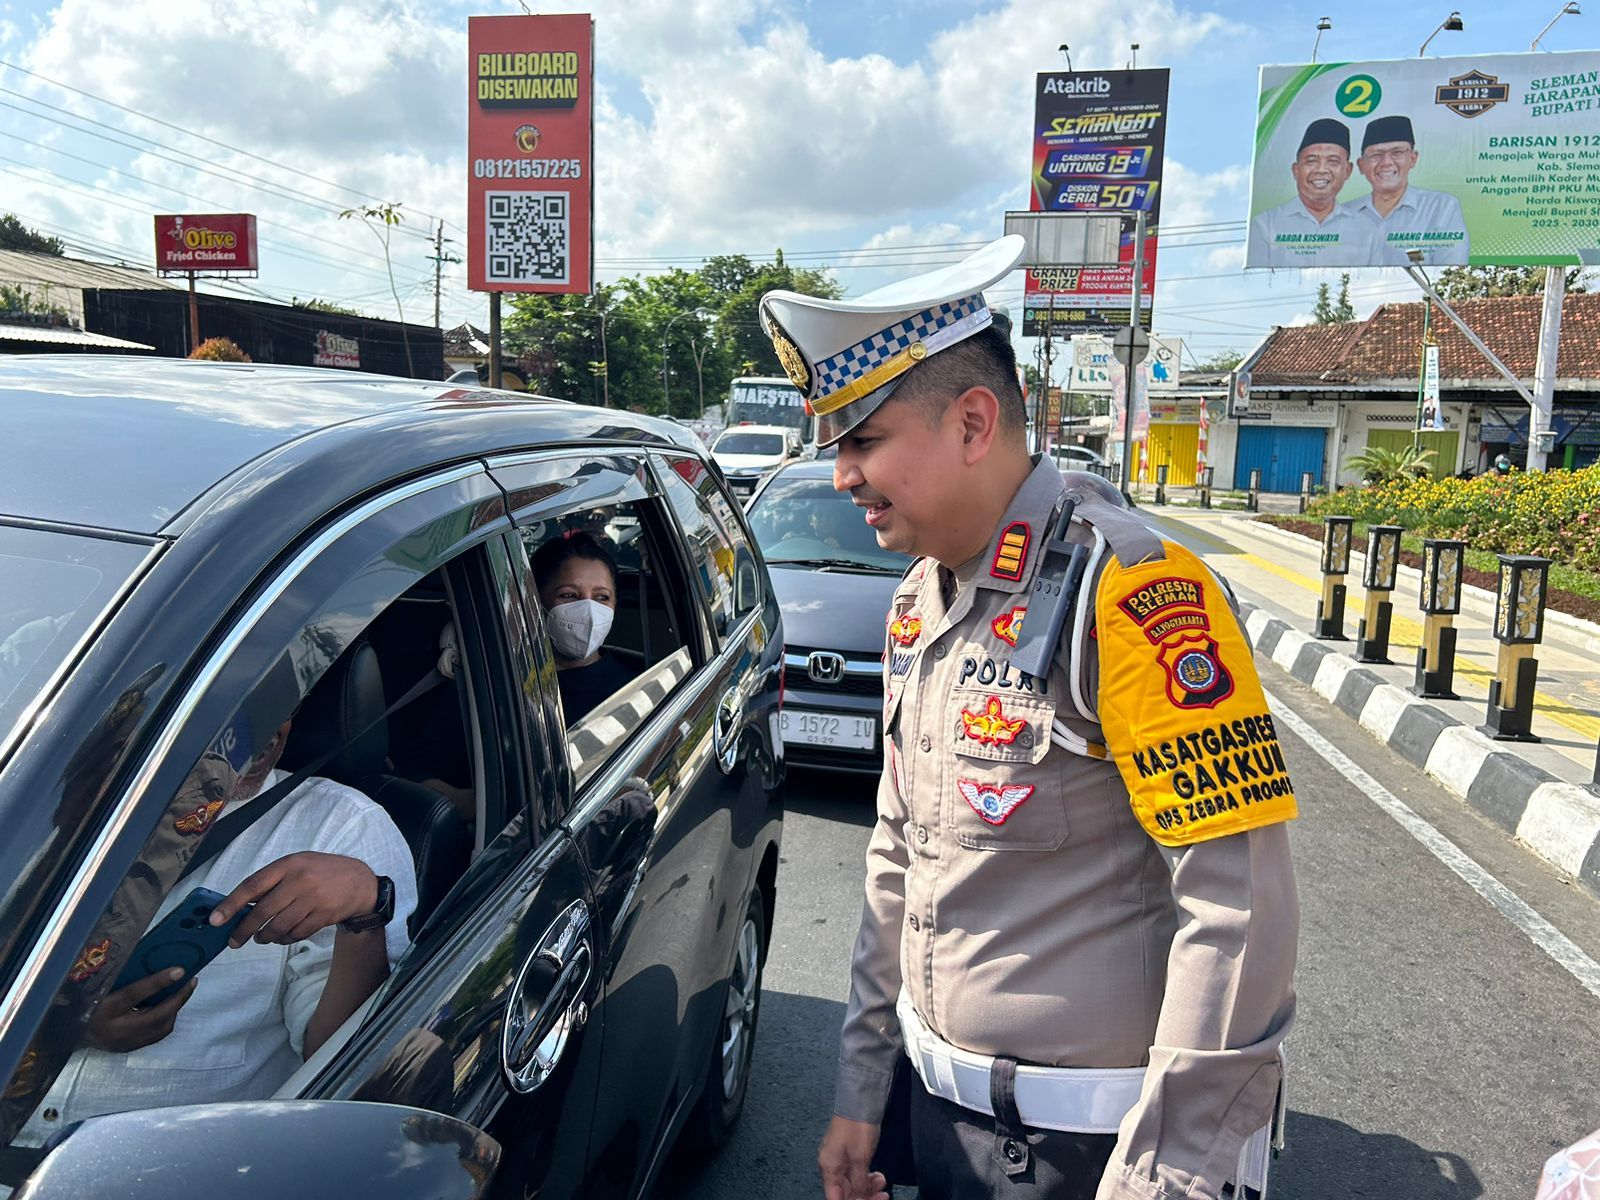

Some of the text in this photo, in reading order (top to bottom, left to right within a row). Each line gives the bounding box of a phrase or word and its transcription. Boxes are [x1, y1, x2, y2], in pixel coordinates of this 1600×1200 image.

[478, 52, 578, 76] BILLBOARD
[478, 78, 578, 100] DISEWAKAN
[1043, 77, 1111, 94] Atakrib
[1530, 71, 1599, 91] SLEMAN
[1343, 79, 1373, 113] 2
[1457, 88, 1489, 99] 1912
[1531, 99, 1592, 117] BUPATI
[1042, 112, 1161, 136] SEMANGAT
[1489, 135, 1600, 147] BARISAN 1912
[1048, 162, 1106, 173] UNTUNG
[1108, 155, 1131, 173] 19
[1478, 151, 1534, 162] Mengajak
[1538, 151, 1575, 161] Warga
[474, 159, 581, 178] 08121557225
[1537, 162, 1561, 171] Kab.
[1465, 174, 1497, 183] untuk
[1500, 174, 1545, 183] Memilih
[1548, 174, 1583, 183] Kader
[1058, 193, 1098, 203] CERIA
[1481, 186, 1528, 195] Anggota
[1532, 185, 1555, 193] BPH
[1525, 196, 1561, 205] Harda
[1502, 207, 1547, 218] Menjadi
[1551, 207, 1587, 218] Bupati
[1532, 219, 1559, 227] 2025
[1572, 219, 1600, 227] 2030
[185, 229, 235, 249] Olive
[1274, 233, 1340, 242] HARDA KISWAYA
[1387, 231, 1464, 241] DANANG MAHARSA
[166, 251, 236, 261] Fried Chicken
[1032, 267, 1079, 289] GRAND PRIZE
[734, 388, 803, 407] MAESTR
[1274, 402, 1309, 412] Animal
[1310, 403, 1335, 413] Care
[1128, 581, 1198, 610] POLRESTA
[1137, 592, 1199, 617] SLEMAN
[780, 713, 873, 738] B 1572 IV
[1155, 807, 1184, 830] OPS
[1185, 791, 1240, 822] ZEBRA
